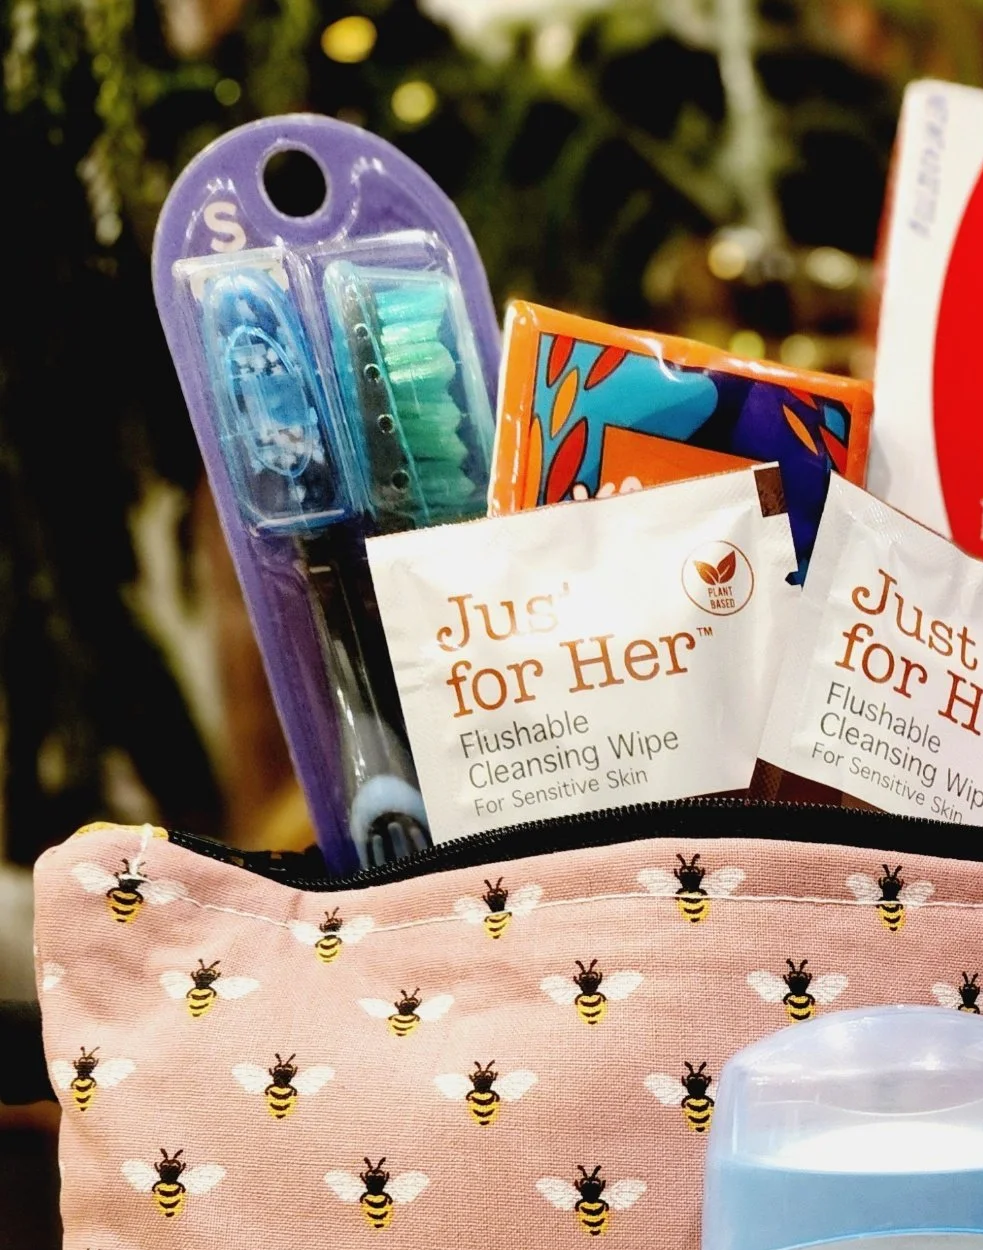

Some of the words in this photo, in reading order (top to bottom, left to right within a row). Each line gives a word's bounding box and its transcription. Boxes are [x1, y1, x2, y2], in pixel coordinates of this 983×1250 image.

[203, 202, 247, 252] S
[436, 581, 571, 653] Jus
[707, 586, 733, 598] PLANT
[709, 598, 736, 611] BASED
[850, 568, 979, 672] Just
[446, 658, 544, 719] for
[834, 622, 929, 699] for
[459, 709, 590, 759] Flushable
[826, 681, 942, 754] Flushable
[468, 742, 600, 791] Cleansing
[608, 728, 680, 763] Wipe
[819, 712, 938, 789] Cleansing
[474, 794, 505, 817] For
[511, 776, 600, 810] Sensitive
[606, 767, 649, 789] Skin
[811, 742, 845, 769] For
[848, 755, 926, 806] Sensitive
[930, 795, 964, 824] Skin
